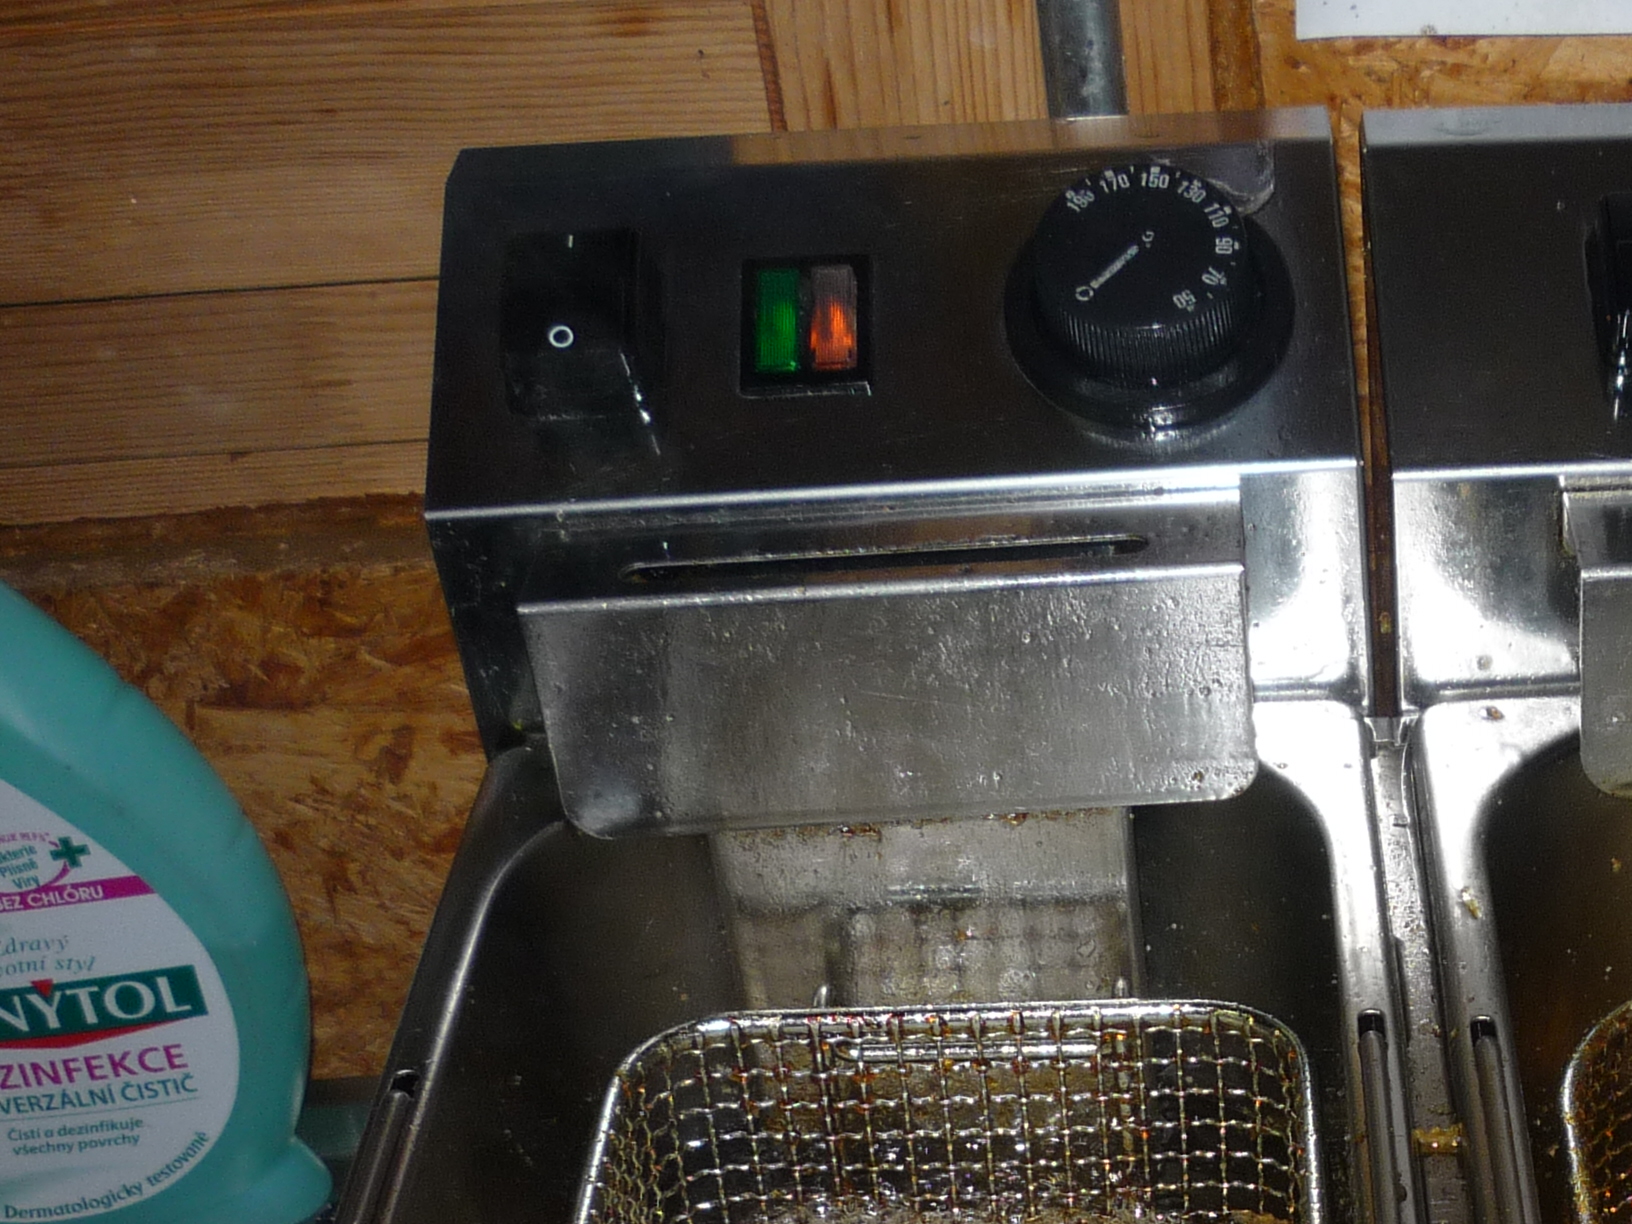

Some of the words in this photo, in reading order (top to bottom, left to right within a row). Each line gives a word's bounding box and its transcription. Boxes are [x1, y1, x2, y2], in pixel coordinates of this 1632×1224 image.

[1100, 174, 1130, 193] 170
[1141, 171, 1169, 188] 150
[1177, 181, 1206, 204] 130
[1204, 203, 1229, 228] 110
[1215, 237, 1233, 255] 90
[1172, 289, 1196, 309] 50
[27, 885, 104, 908] CHLÓRU
[0, 935, 69, 956] dravý
[55, 955, 96, 975] styl
[120, 1072, 198, 1102] ČISTIČ
[44, 1129, 54, 1139] a
[57, 1117, 144, 1138] dezinfikuje
[12, 1140, 75, 1157] všechny
[78, 1133, 140, 1153] povrchy
[5, 1181, 144, 1219] Dermatologicky
